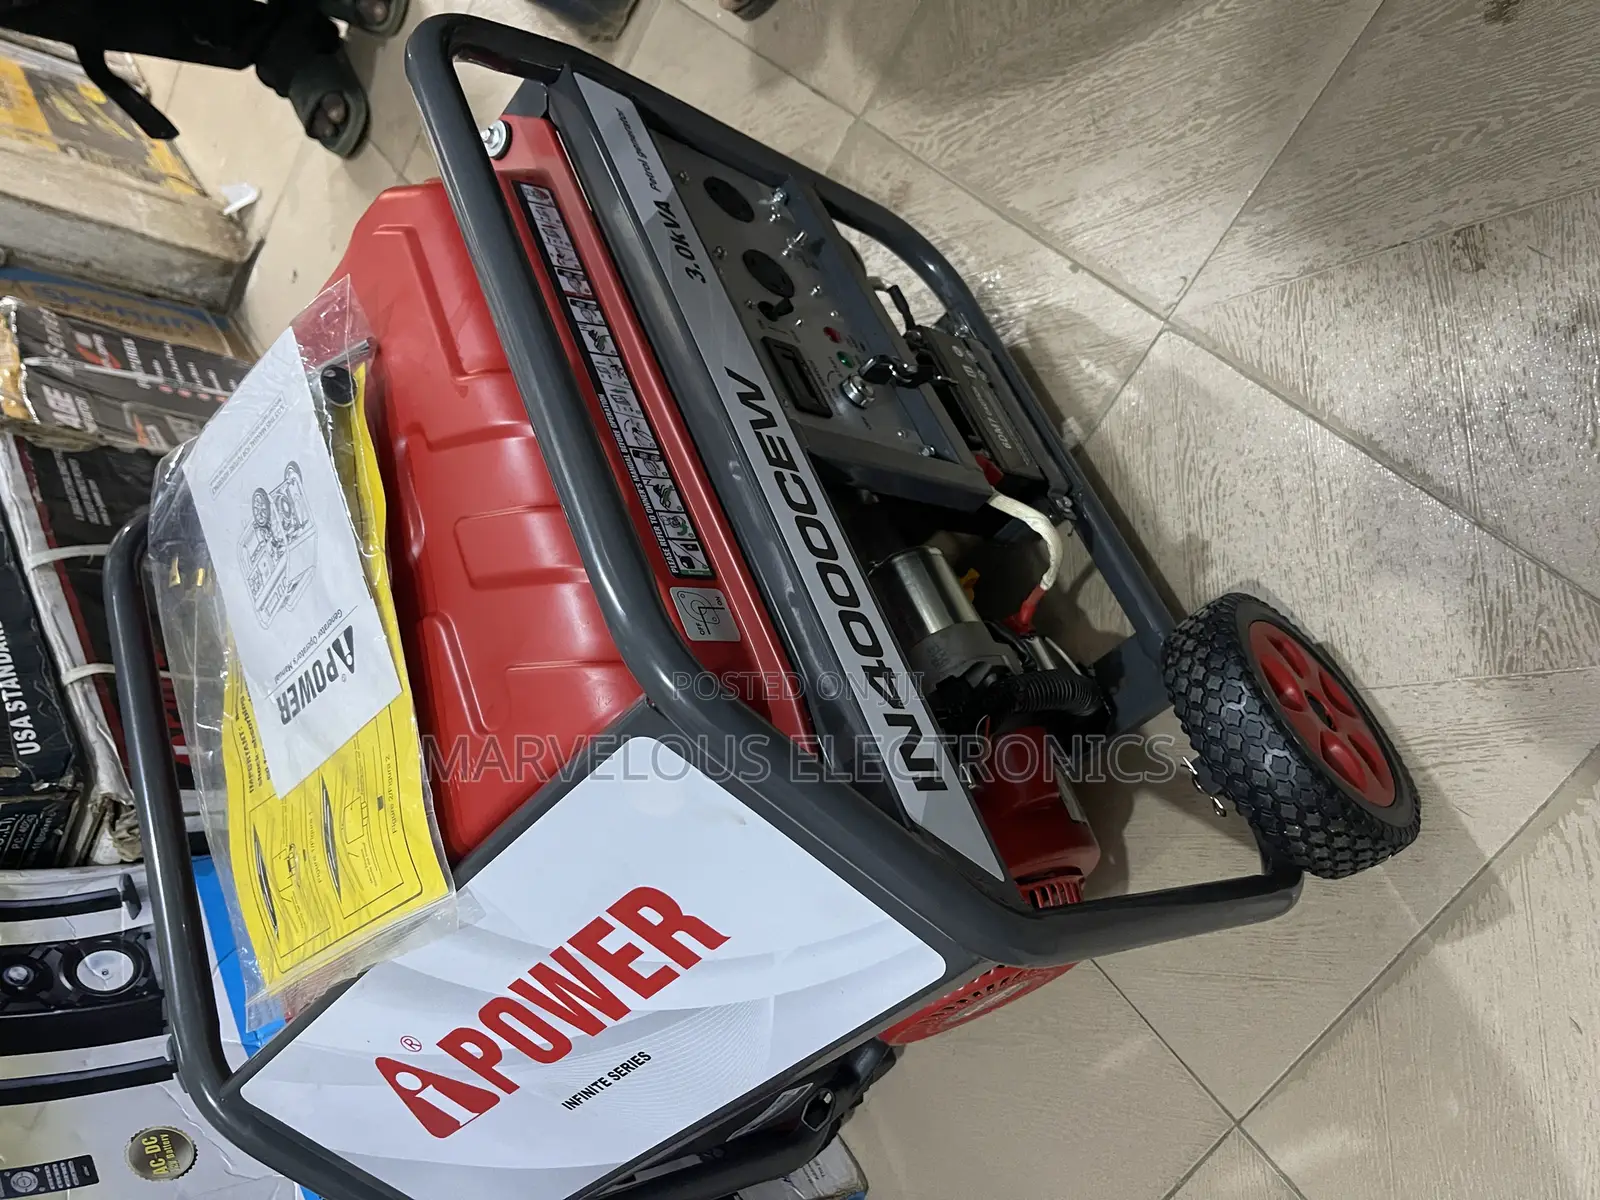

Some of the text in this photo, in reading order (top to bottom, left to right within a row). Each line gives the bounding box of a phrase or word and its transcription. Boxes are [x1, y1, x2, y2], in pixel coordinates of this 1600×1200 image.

[616, 107, 707, 284] 3.0kVA Petrol generator
[597, 393, 679, 572] PLEASE REFER TO OWNER'S MANUAL BEFORE OPERATION
[725, 366, 948, 791] IN4000CEW
[715, 596, 723, 606] ON
[275, 608, 343, 684] Generator Operator's Manual
[696, 622, 706, 636] OFF
[9, 714, 41, 756] USA
[238, 726, 254, 792] IMPORTANT:
[389, 802, 397, 834] Figure
[312, 855, 323, 883] Figure
[561, 1051, 652, 1111] INFINITE SERIES
[141, 1136, 170, 1175] AC-DC
[160, 1134, 176, 1159] Battery
